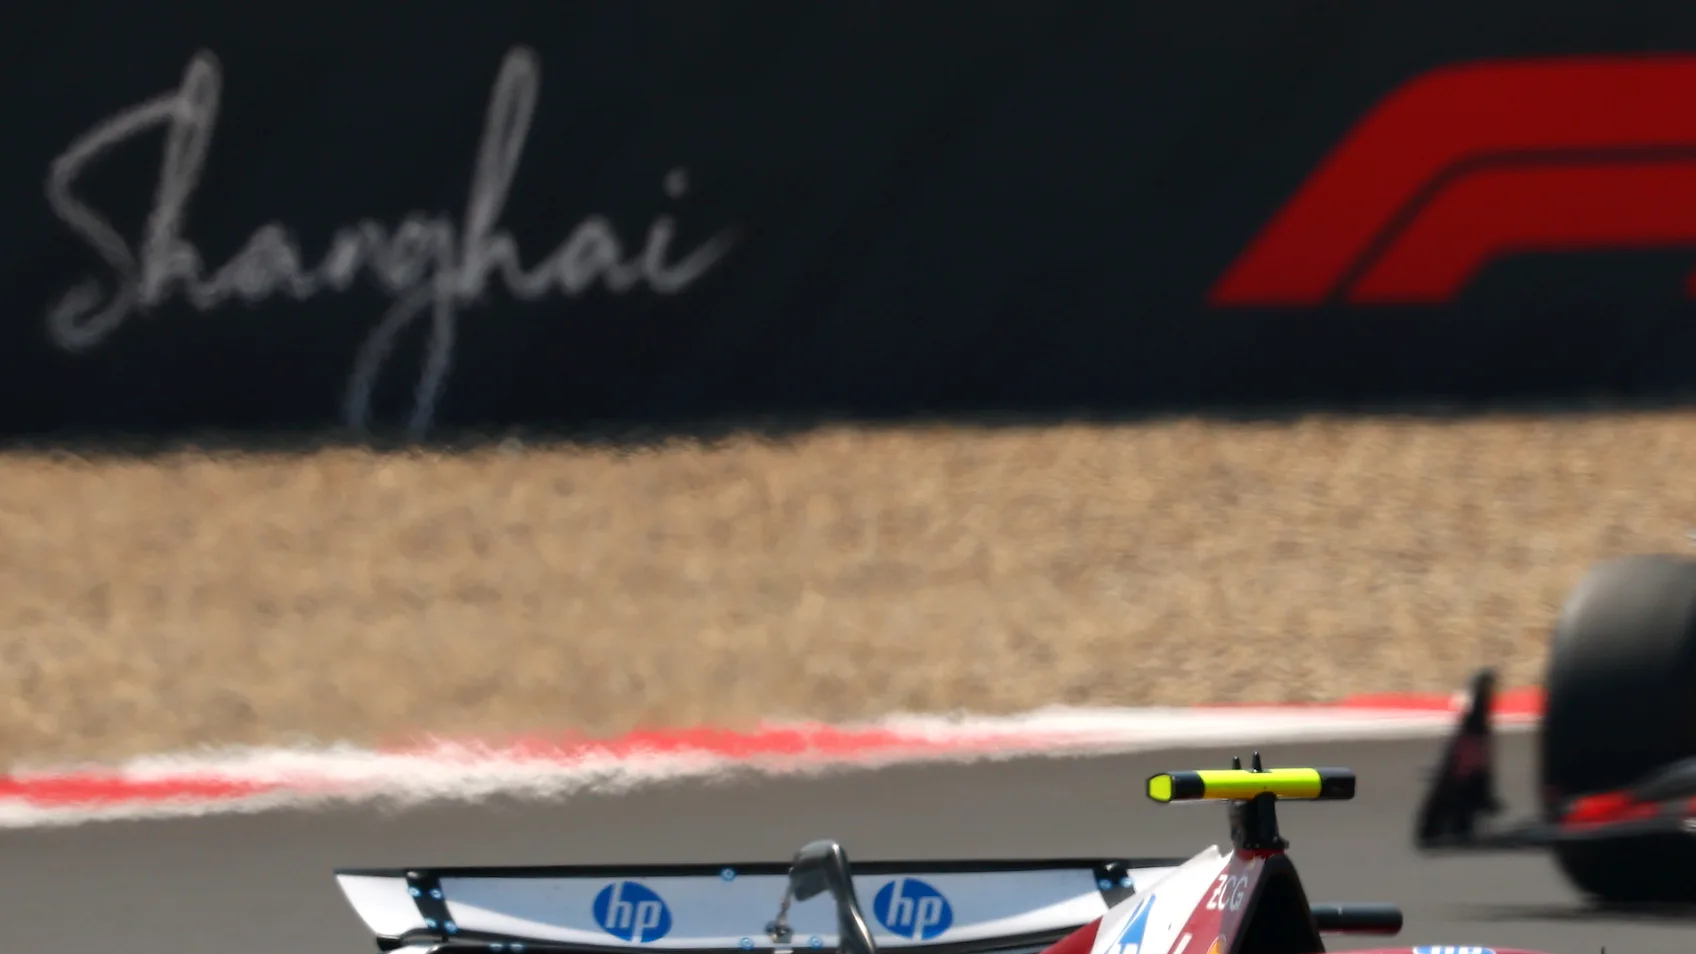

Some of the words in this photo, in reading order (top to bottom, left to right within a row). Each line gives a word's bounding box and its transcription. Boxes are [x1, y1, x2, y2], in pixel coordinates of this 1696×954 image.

[46, 46, 738, 434] Shanghai
[604, 881, 664, 943] hp
[884, 879, 944, 941] hp
